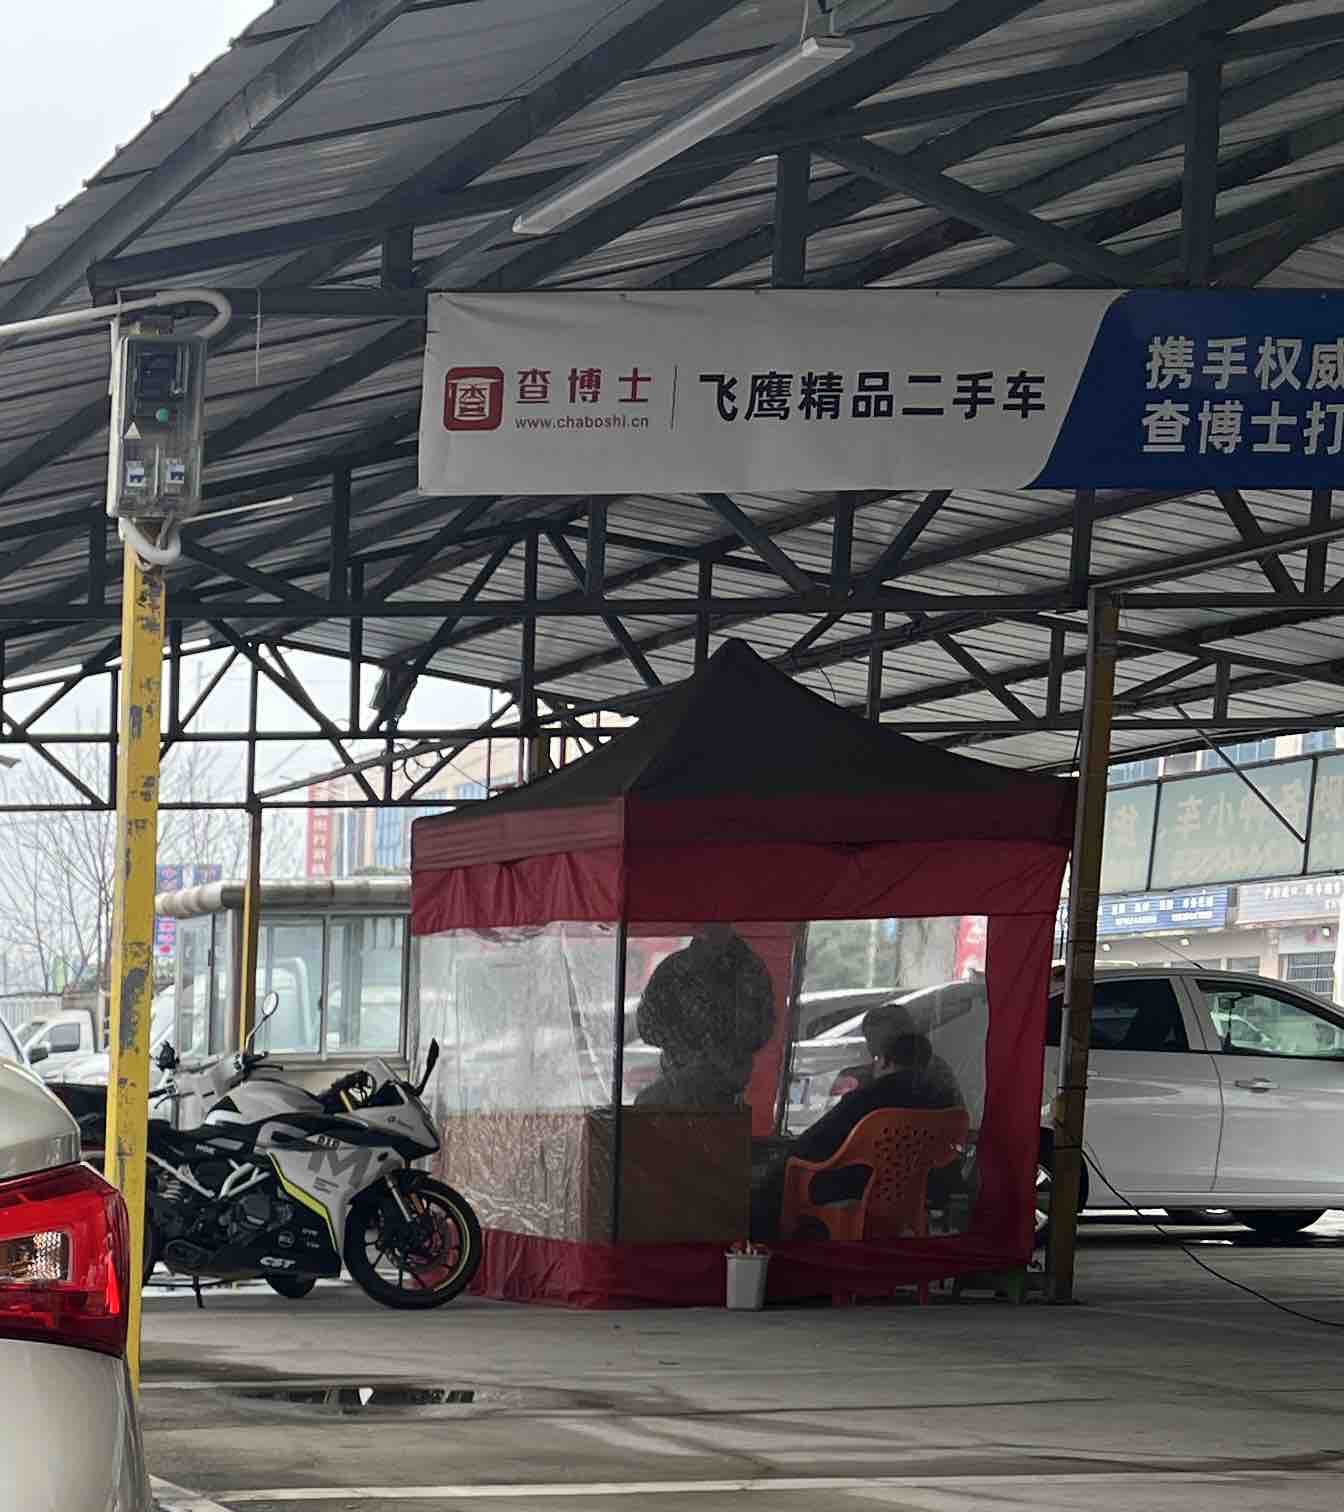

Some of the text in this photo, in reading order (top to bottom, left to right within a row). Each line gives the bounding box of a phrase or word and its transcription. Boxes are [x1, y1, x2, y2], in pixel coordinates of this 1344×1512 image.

[515, 368, 652, 404] 查博士
[1145, 335, 1344, 391] 携手权威
[698, 370, 1047, 421] 飞鹰精品二手车
[515, 415, 649, 430] www.chaboshi.cn
[1141, 399, 1344, 455] 查博士打
